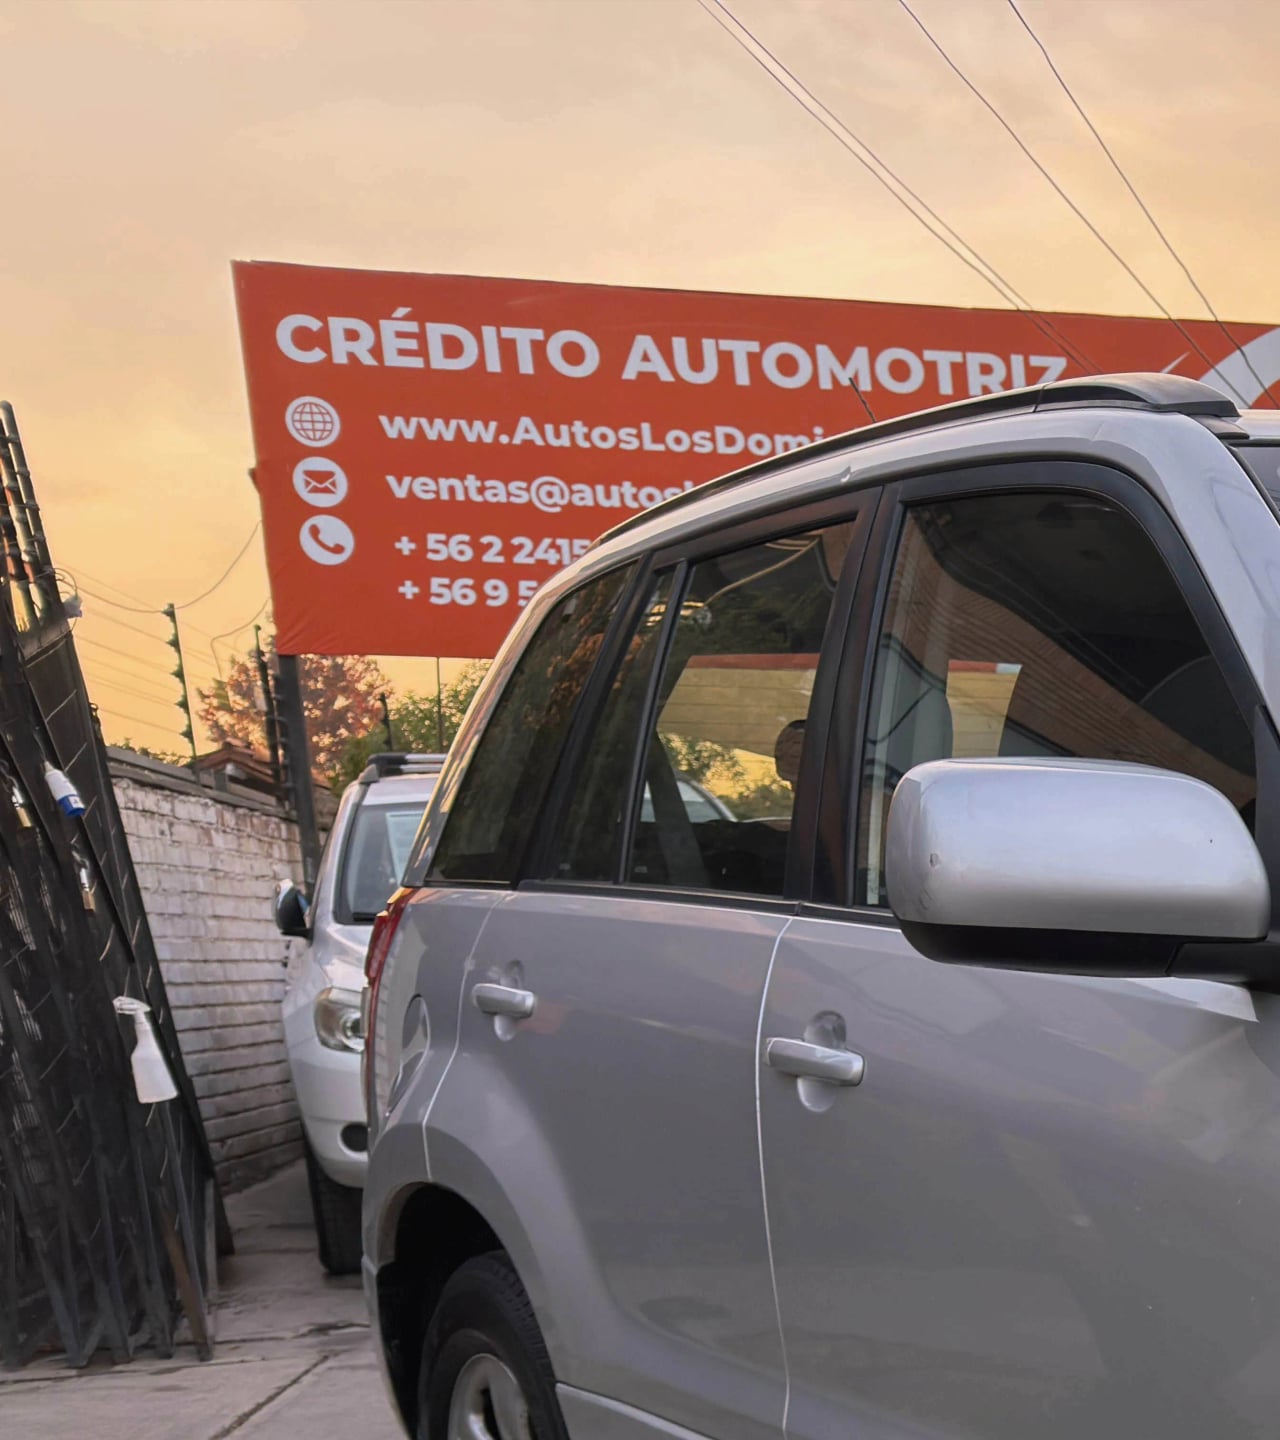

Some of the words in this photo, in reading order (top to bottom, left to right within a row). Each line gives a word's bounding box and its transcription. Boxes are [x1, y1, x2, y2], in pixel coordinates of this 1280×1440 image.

[275, 307, 600, 378] CRÉDITO
[622, 335, 1067, 396] AUTOMOTRIZ
[426, 533, 474, 562] 56
[479, 535, 505, 563] 2
[429, 577, 477, 606] 56
[483, 579, 509, 607] 9
